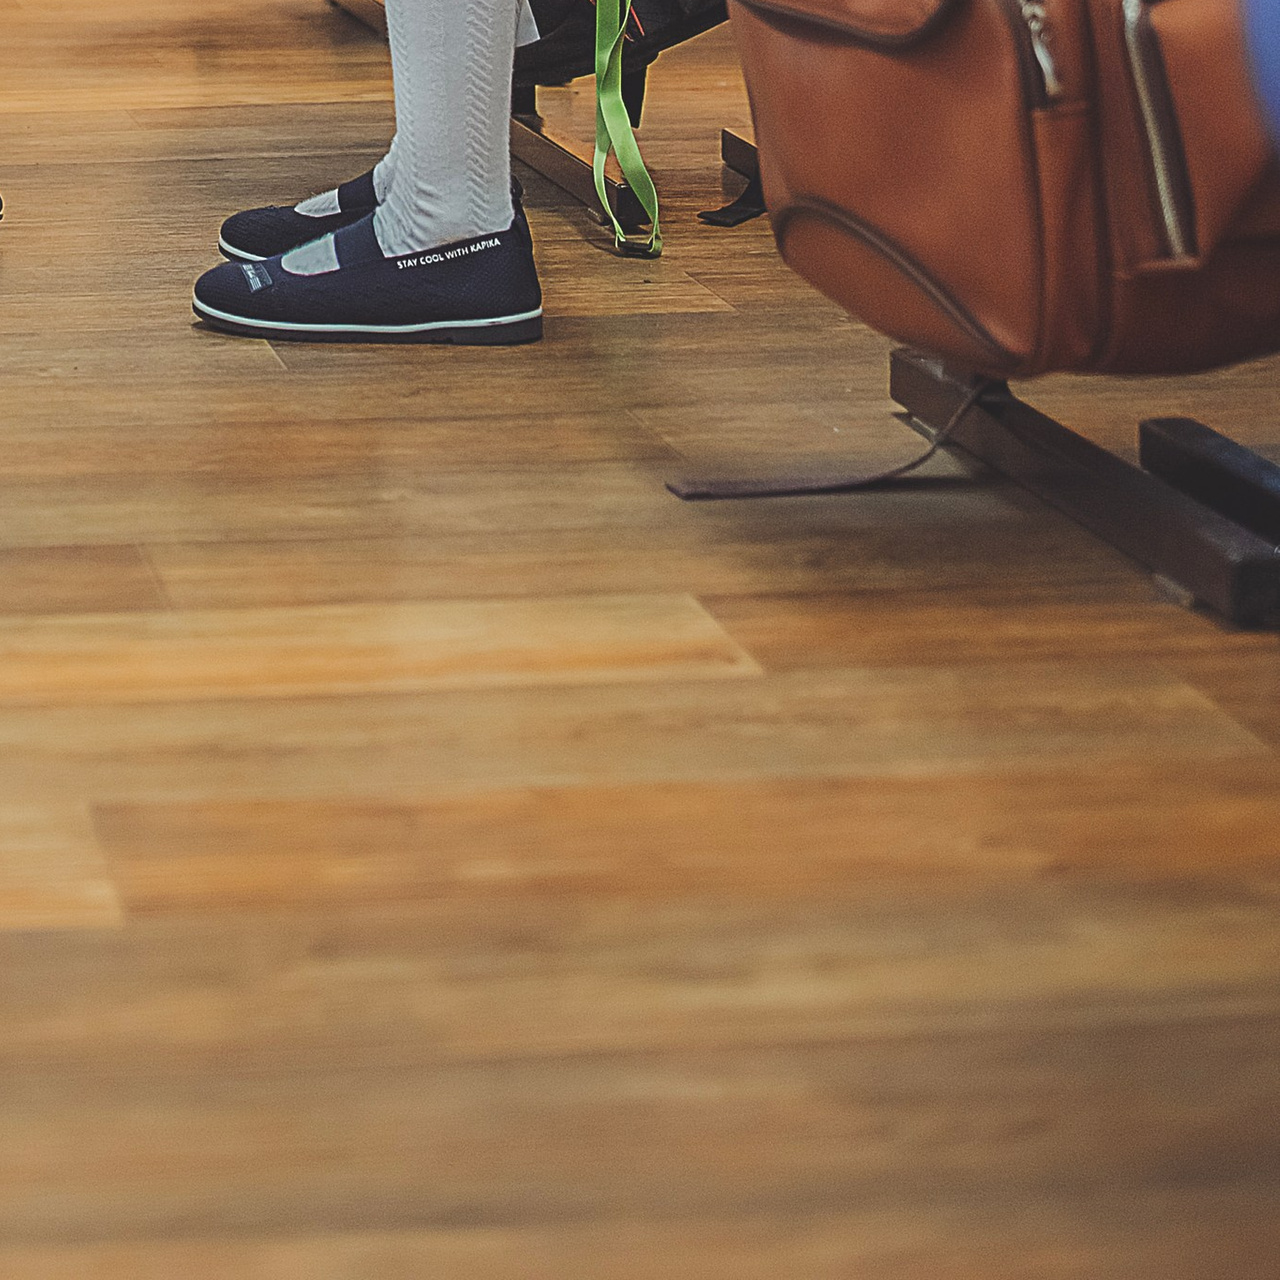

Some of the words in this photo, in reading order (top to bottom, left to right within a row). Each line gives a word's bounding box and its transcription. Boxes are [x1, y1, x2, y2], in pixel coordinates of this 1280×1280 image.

[397, 258, 418, 269] STAY
[420, 254, 445, 265] COOL
[445, 246, 469, 260] WITH
[470, 237, 501, 253] KAPIKA
